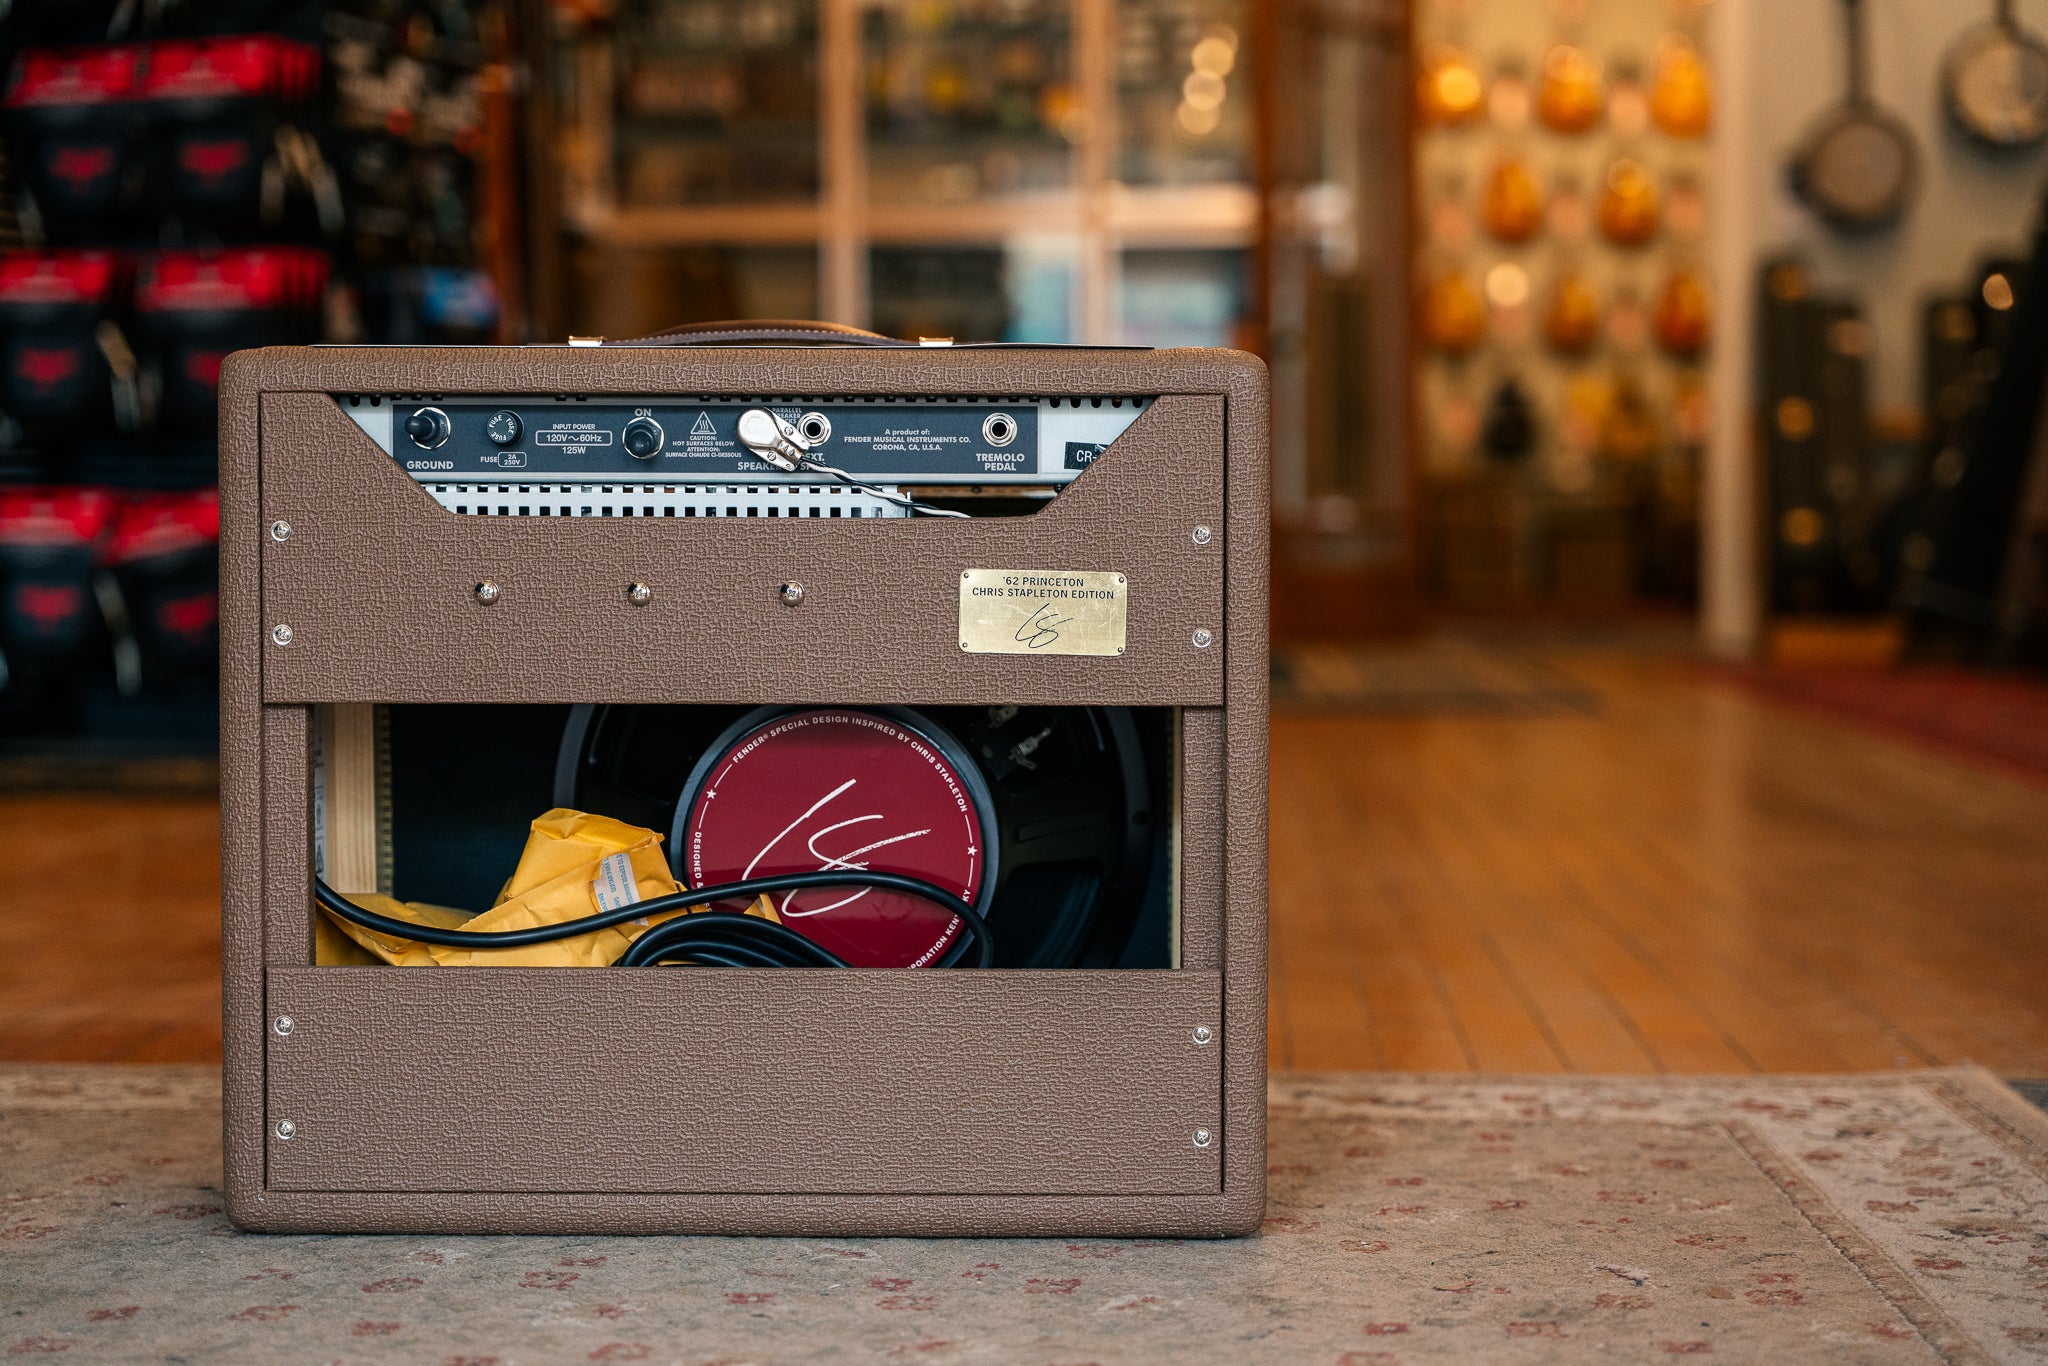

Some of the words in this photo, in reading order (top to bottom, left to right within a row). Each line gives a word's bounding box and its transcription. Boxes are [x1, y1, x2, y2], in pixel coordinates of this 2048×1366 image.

[634, 408, 652, 417] ON
[488, 414, 503, 428] FUSE
[506, 418, 515, 434] FUSE
[491, 432, 507, 440] FUSE
[892, 428, 919, 436] product
[976, 453, 1025, 462] TREMOLO
[406, 460, 454, 470] GROUND
[984, 462, 1016, 471] PEDAL
[1022, 577, 1084, 587] PRINCETON
[972, 588, 1004, 596] CHRIS
[1008, 588, 1068, 598] STAPLETON
[1072, 590, 1114, 600] EDITION
[770, 719, 810, 737] SPECIAL
[812, 716, 848, 724] DESIGN
[852, 717, 896, 736] INSPIRED
[897, 733, 910, 743] BY
[910, 742, 936, 764] CHRIS
[934, 763, 968, 812] STAPLETON
[693, 831, 702, 879] DESIGNED
